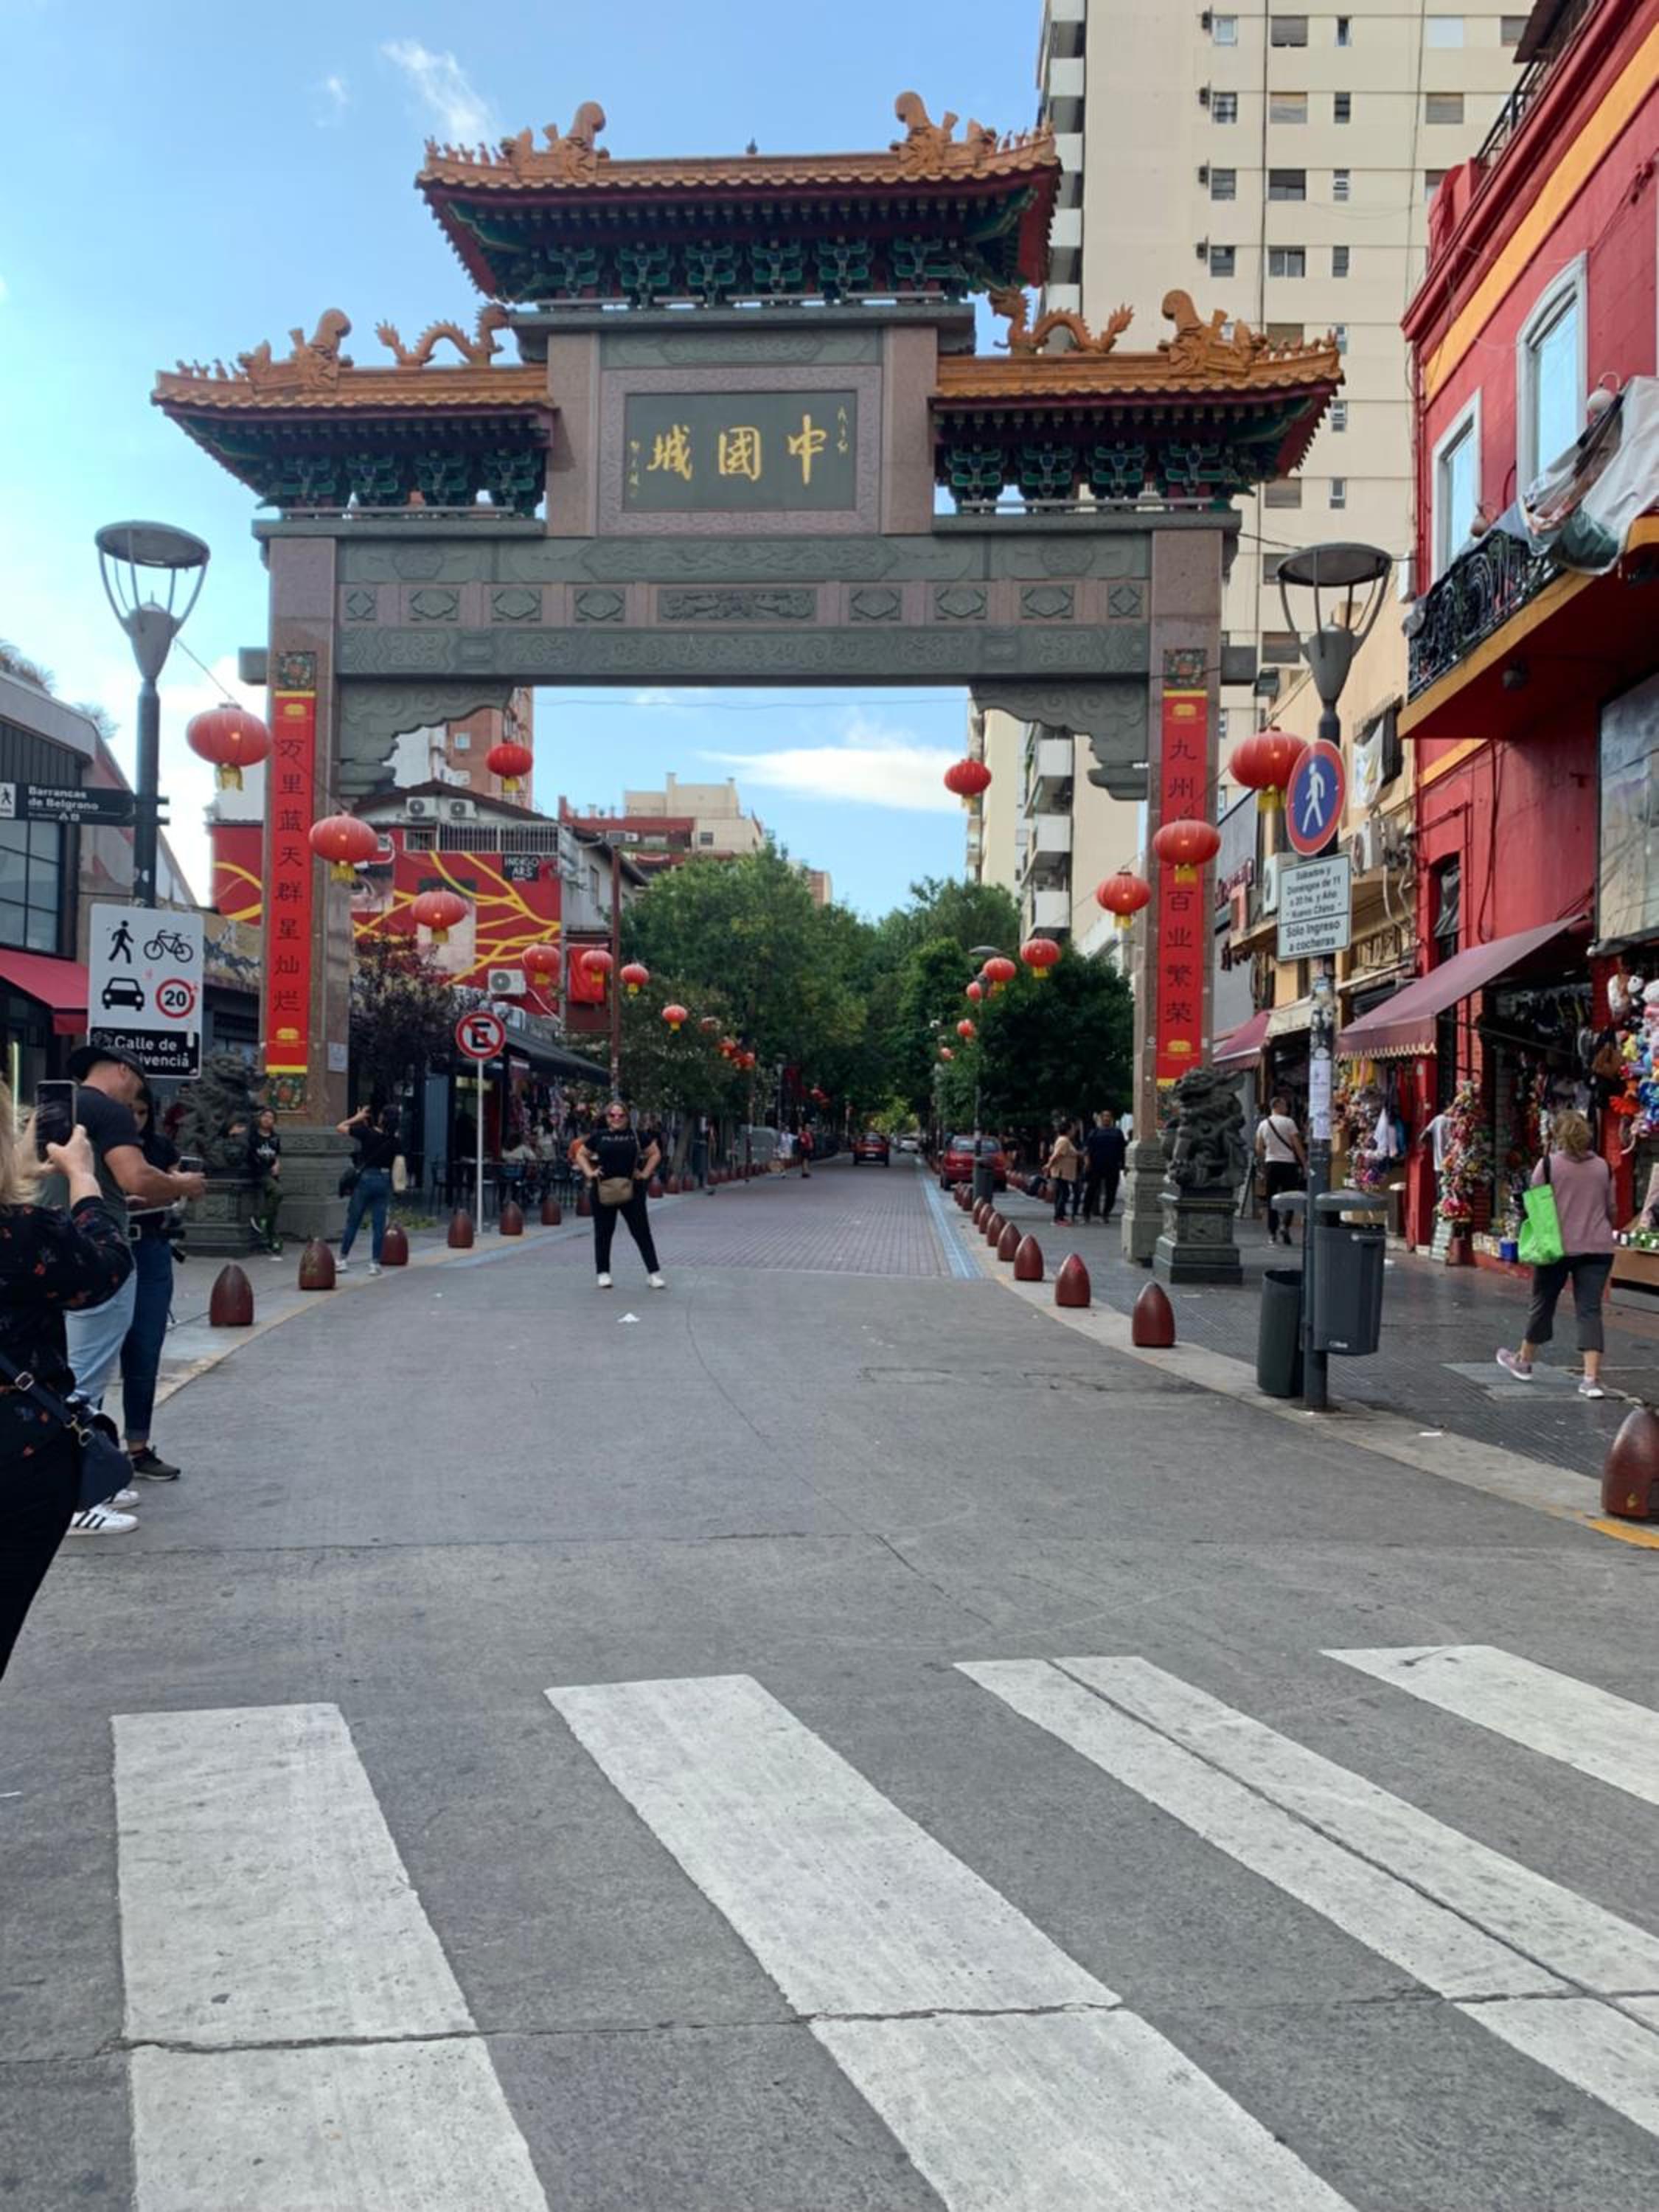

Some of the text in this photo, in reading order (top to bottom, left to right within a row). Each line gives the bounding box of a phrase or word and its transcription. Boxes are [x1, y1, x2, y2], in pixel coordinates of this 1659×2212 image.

[647, 414, 827, 485] 中國城
[28, 786, 87, 799] Barrancas
[28, 797, 100, 811] de Belgrano
[274, 739, 305, 1012] 万里蓝天群星灿烂
[1164, 738, 1197, 1026] 九州百业繁荣
[1296, 936, 1335, 951] cocheras
[164, 990, 187, 1007] 20
[114, 1035, 178, 1051] Calle de
[138, 1052, 190, 1068] ivencia
